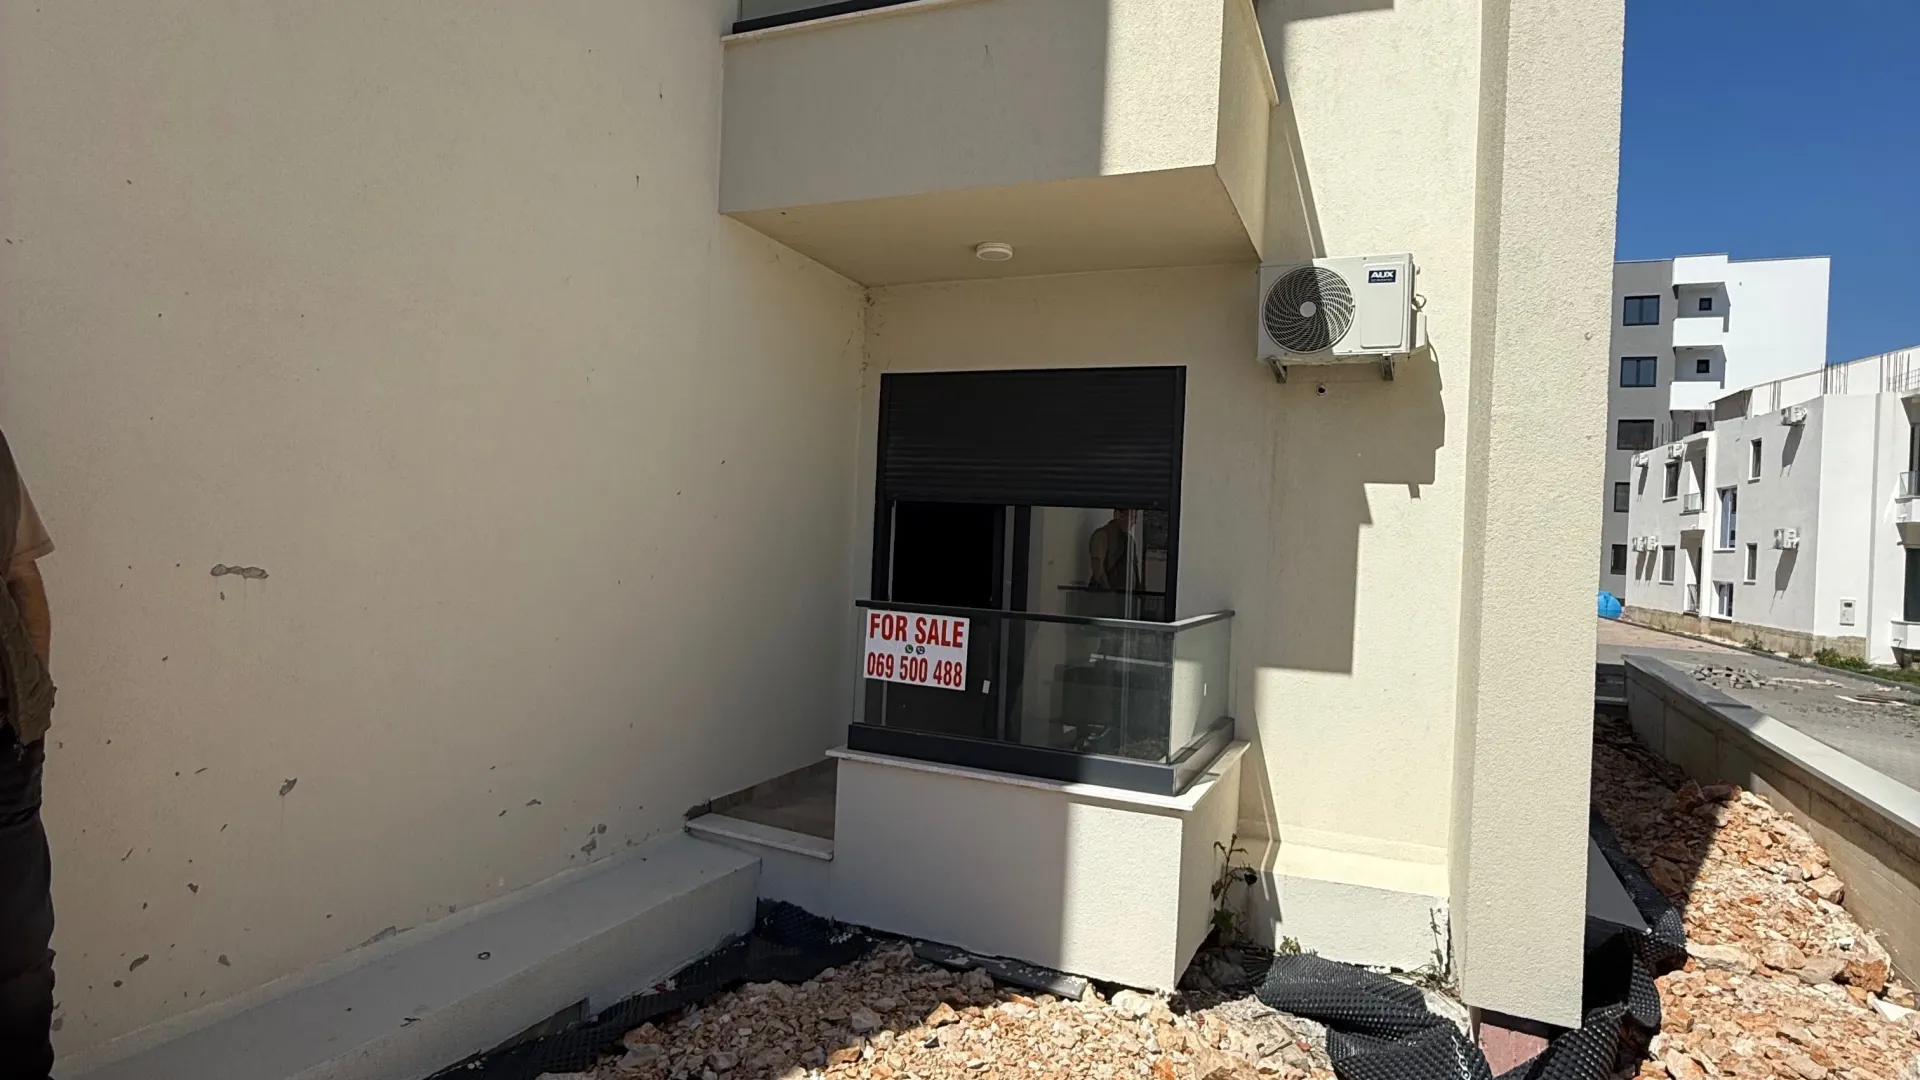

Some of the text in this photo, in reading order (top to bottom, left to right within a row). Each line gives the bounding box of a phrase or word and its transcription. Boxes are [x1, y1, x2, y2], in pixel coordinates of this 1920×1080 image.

[869, 613, 965, 648] FOR SALE
[867, 652, 963, 688] 069 500 488
